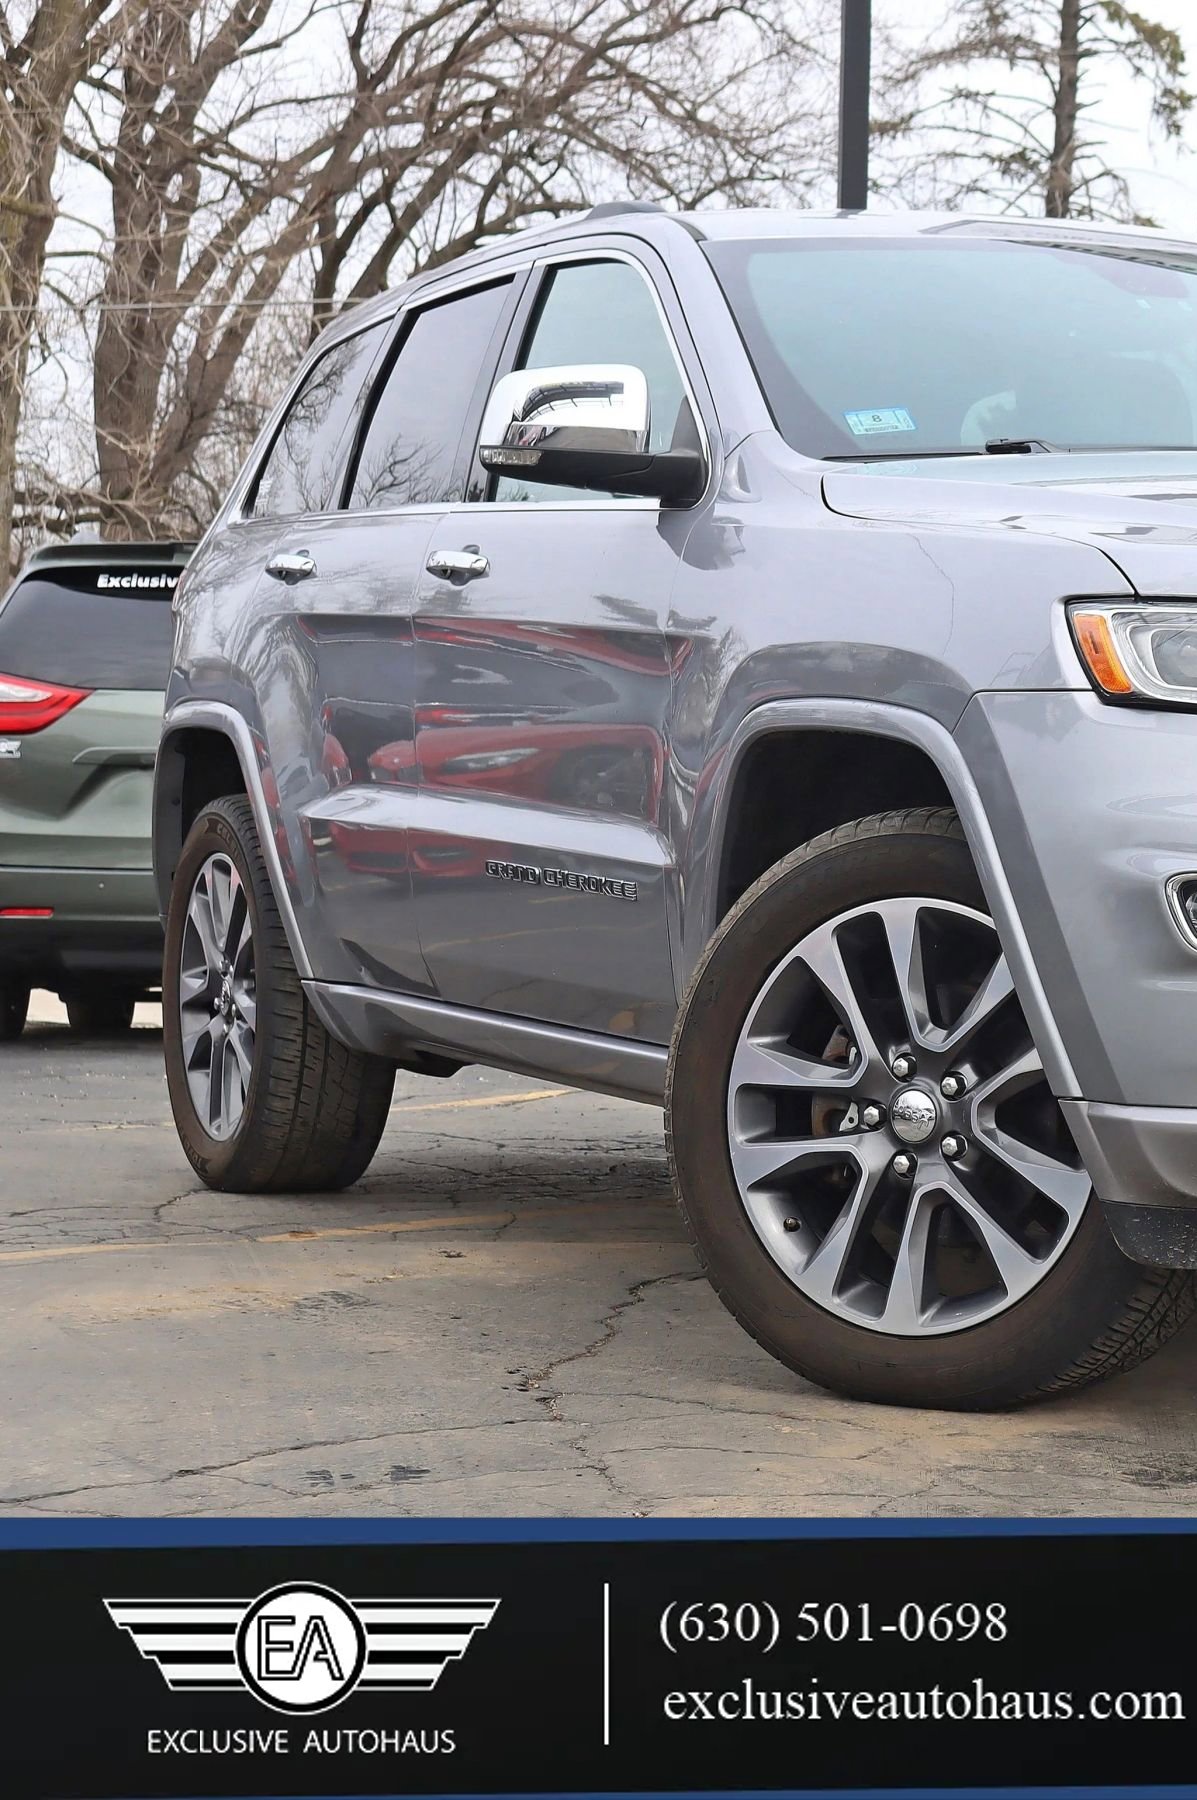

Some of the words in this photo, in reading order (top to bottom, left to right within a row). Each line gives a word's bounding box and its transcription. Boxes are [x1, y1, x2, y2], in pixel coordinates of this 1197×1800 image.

[97, 573, 179, 588] Exclusiv
[486, 860, 542, 885] GRAND
[543, 867, 638, 901] CHEROKEE
